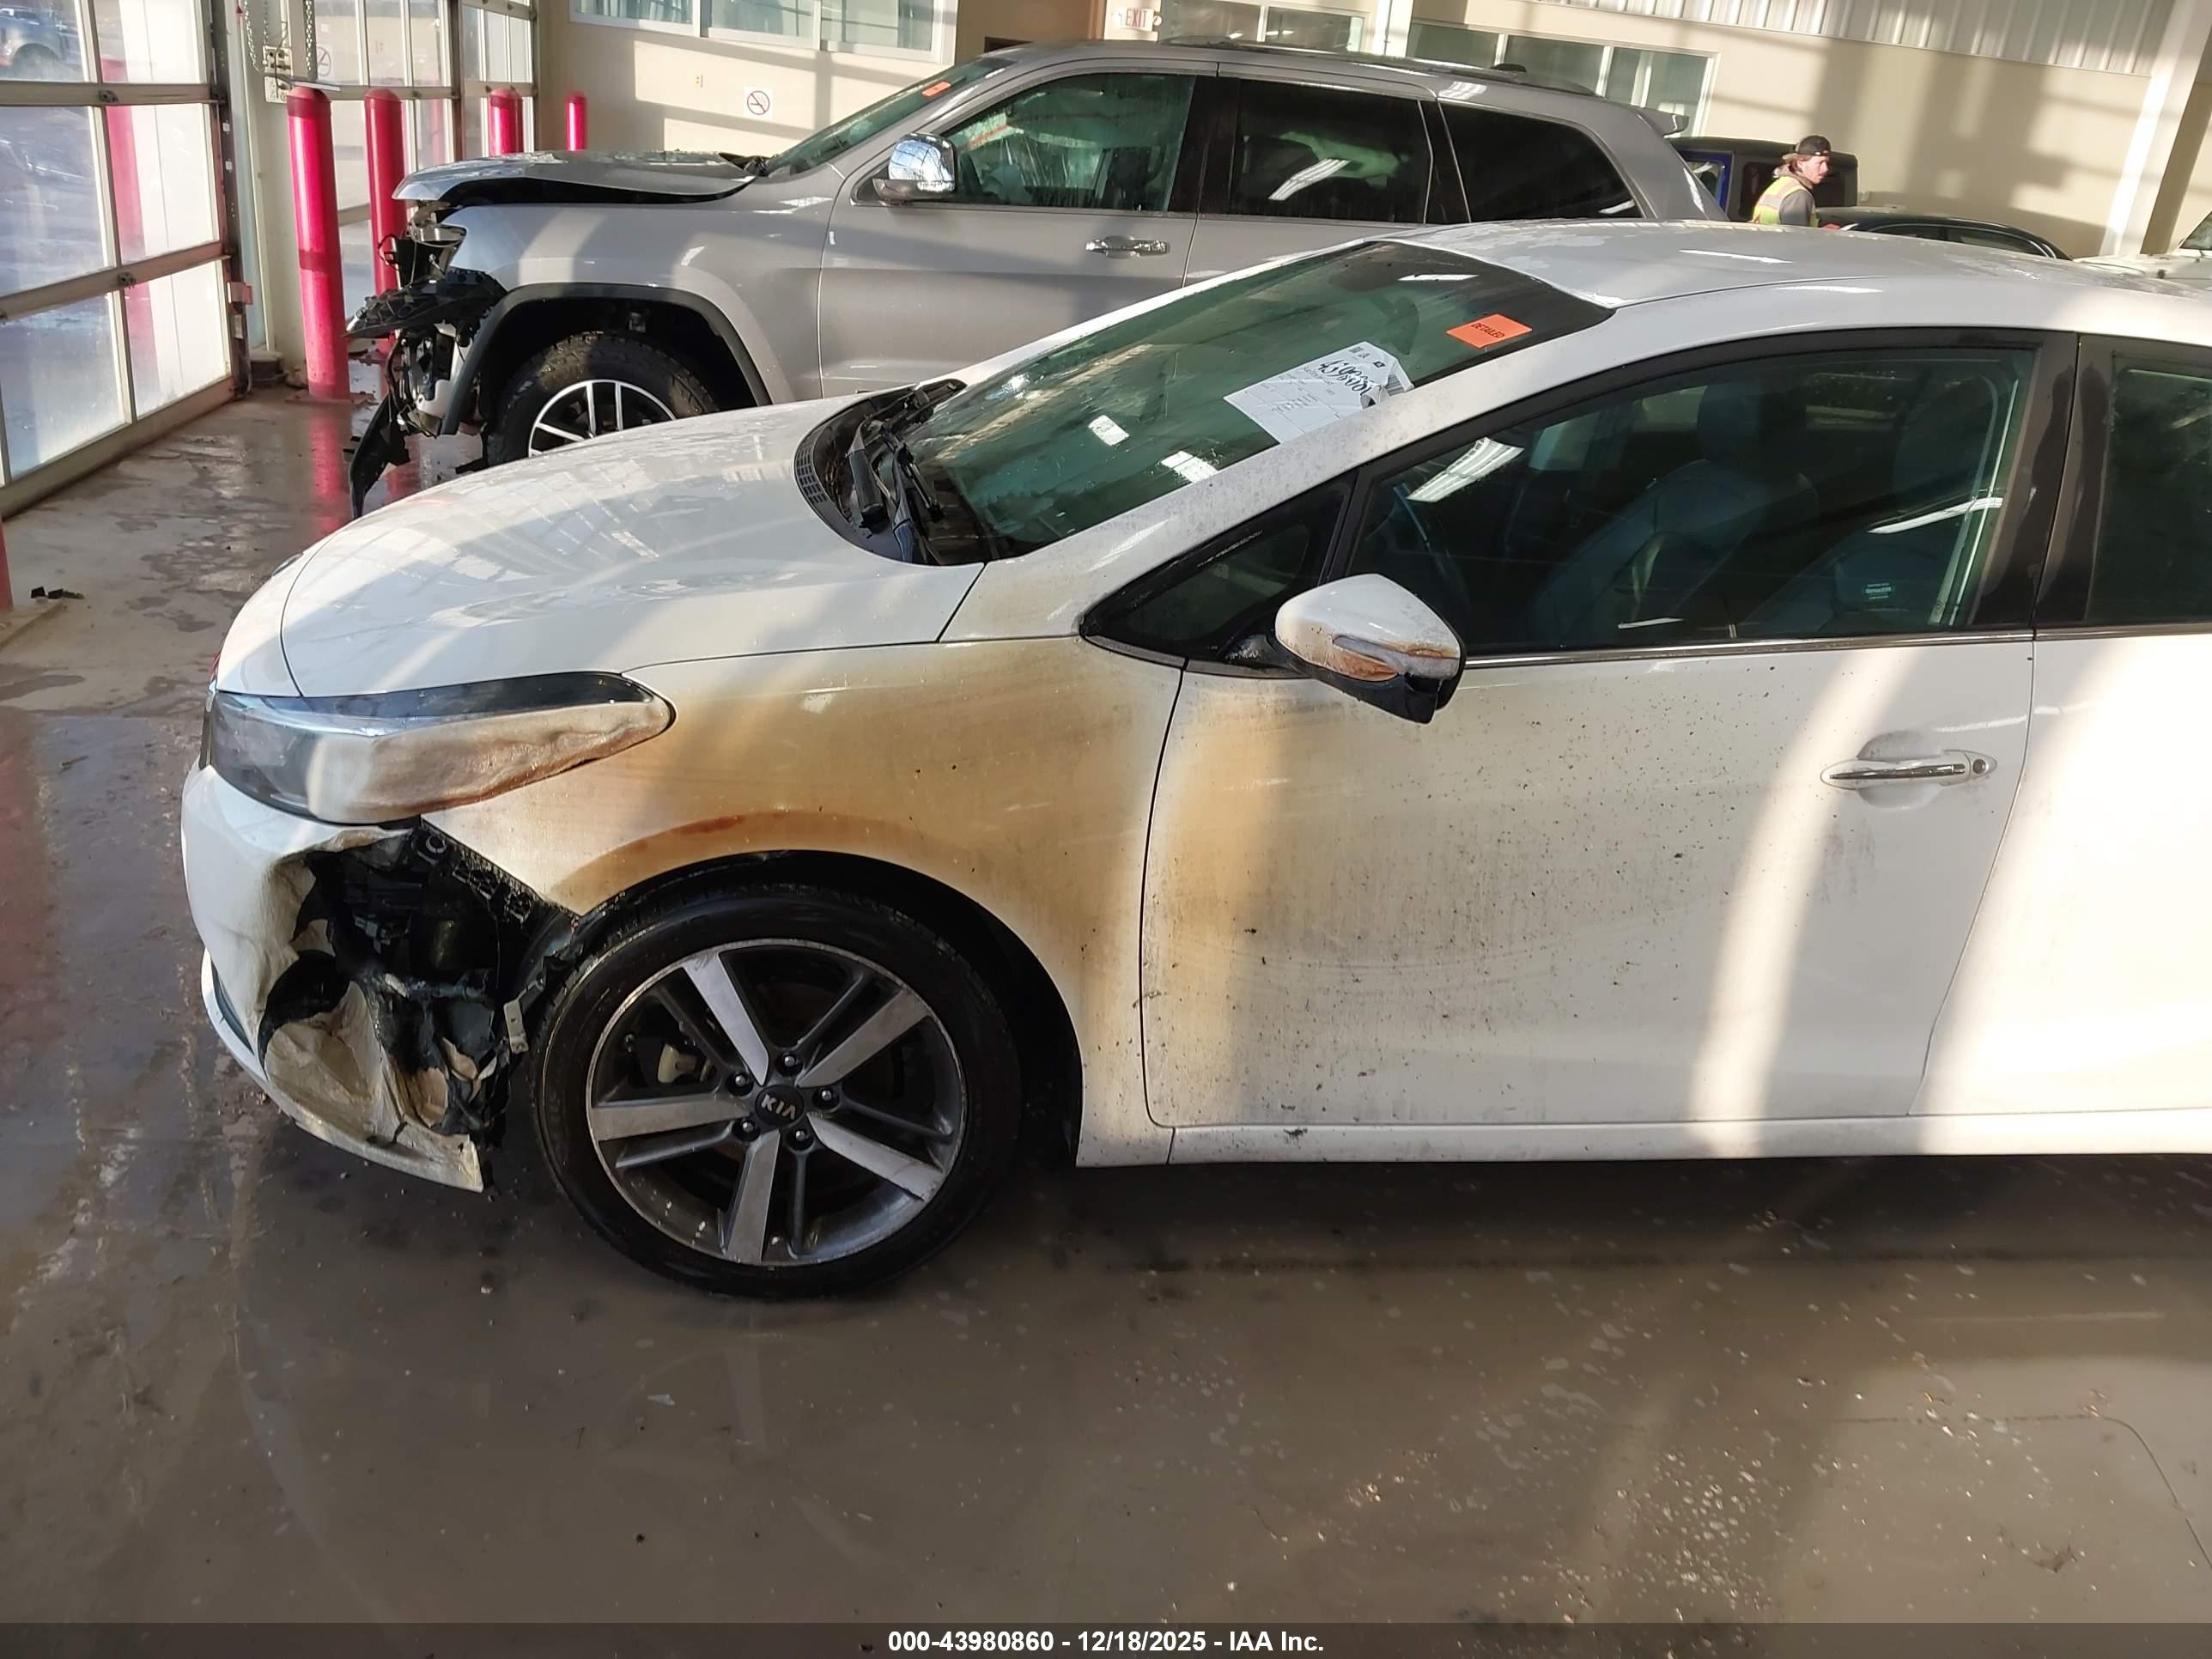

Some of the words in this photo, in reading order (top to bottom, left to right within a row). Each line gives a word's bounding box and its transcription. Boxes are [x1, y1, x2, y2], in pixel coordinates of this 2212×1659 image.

[1125, 8, 1148, 27] EXIT
[1470, 322, 1505, 338] DETAILED
[761, 1093, 797, 1121] KIA
